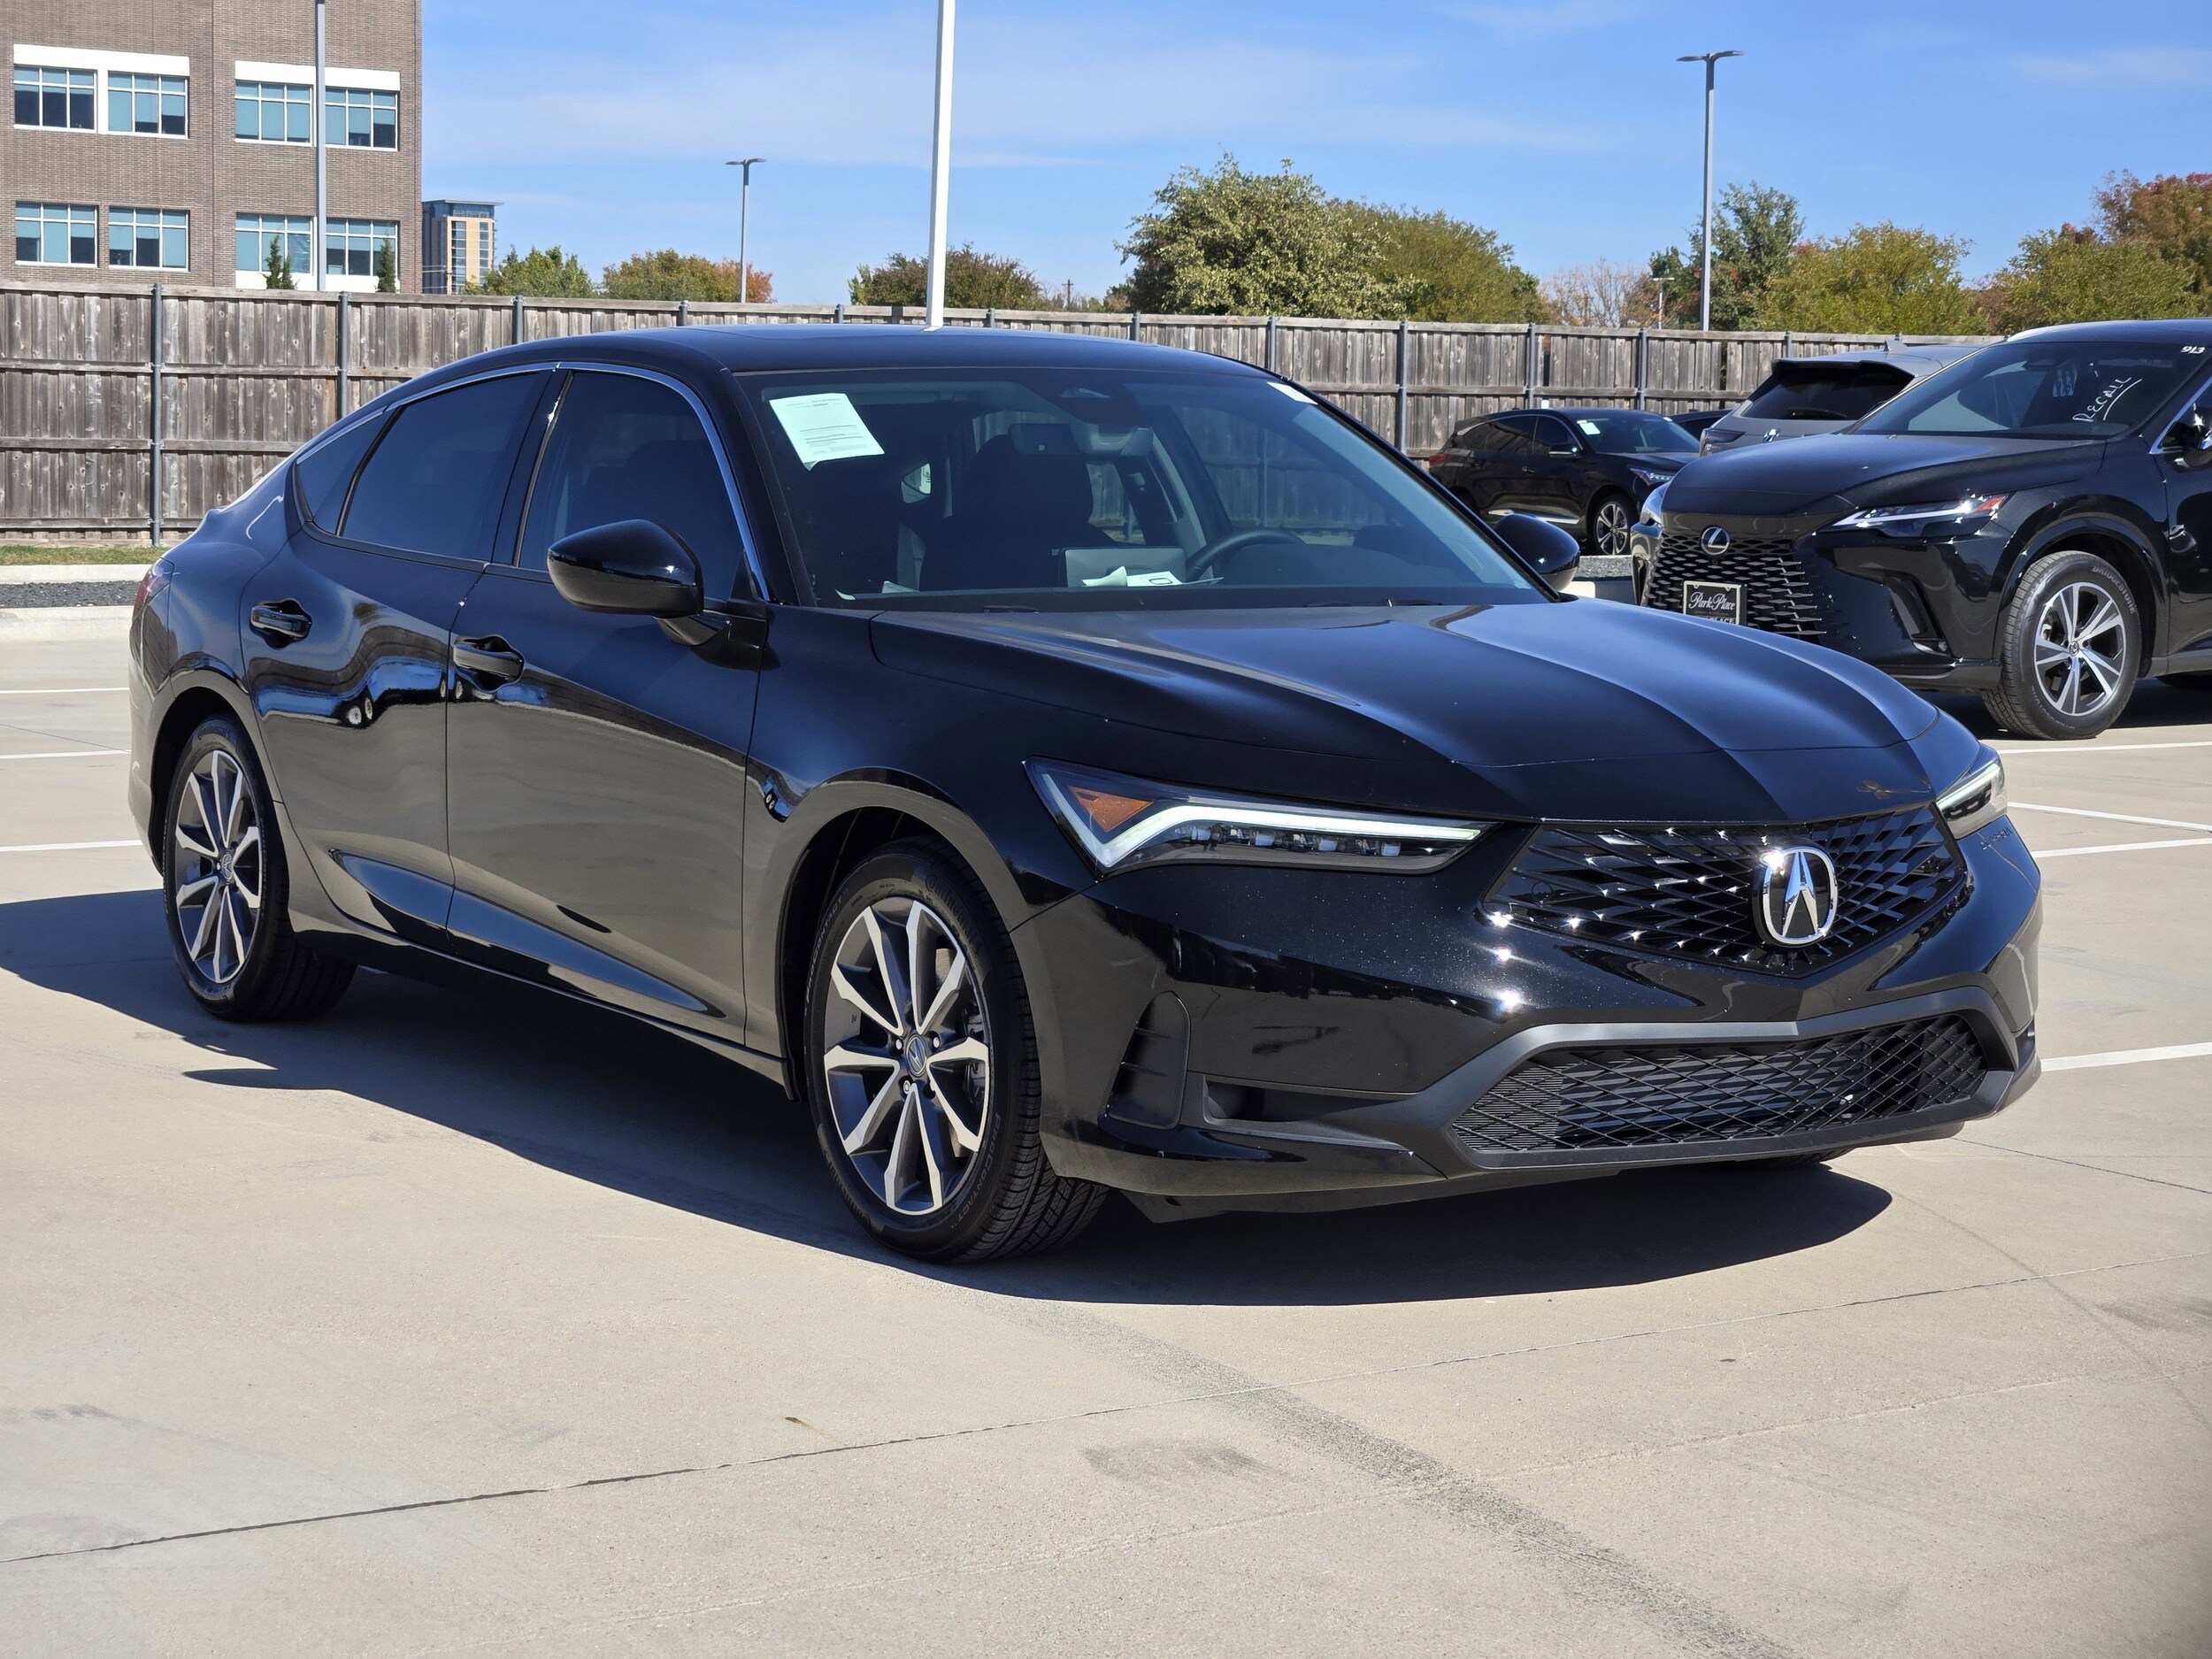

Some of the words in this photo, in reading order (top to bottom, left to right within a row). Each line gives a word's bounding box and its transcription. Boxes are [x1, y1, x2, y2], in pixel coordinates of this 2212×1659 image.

[2180, 345, 2205, 354] 913
[1688, 591, 1713, 609] Park
[1710, 593, 1736, 611] Place
